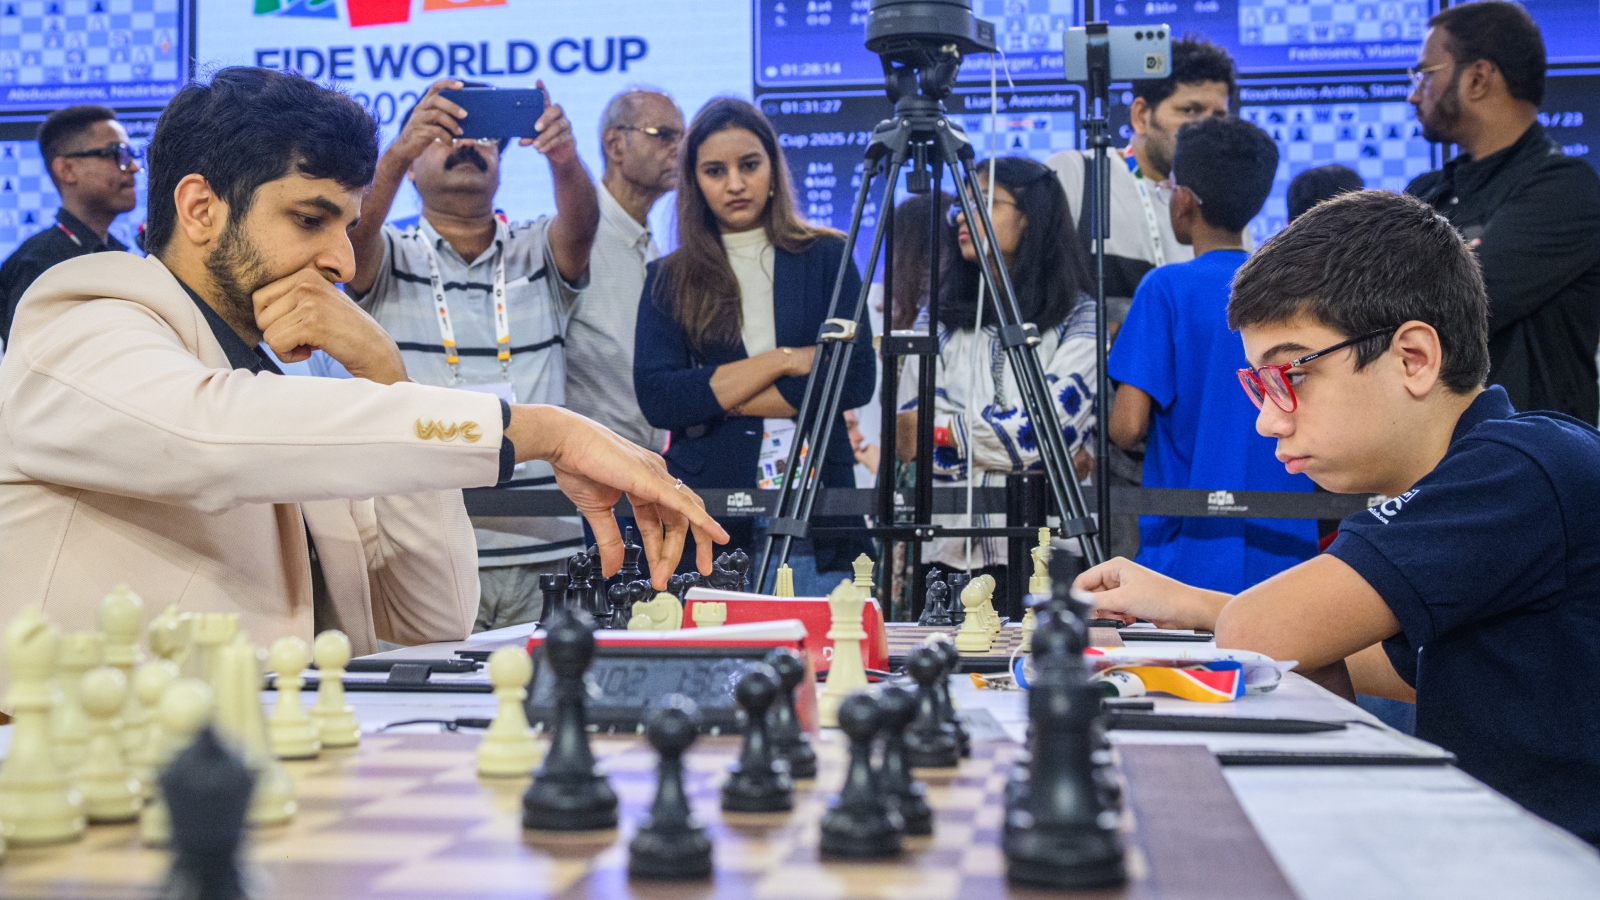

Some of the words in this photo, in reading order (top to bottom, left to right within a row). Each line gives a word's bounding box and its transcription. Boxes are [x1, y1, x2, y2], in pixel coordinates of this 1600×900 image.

[256, 46, 355, 80] FIDE
[365, 39, 540, 79] WORLD
[548, 36, 649, 75] CUP
